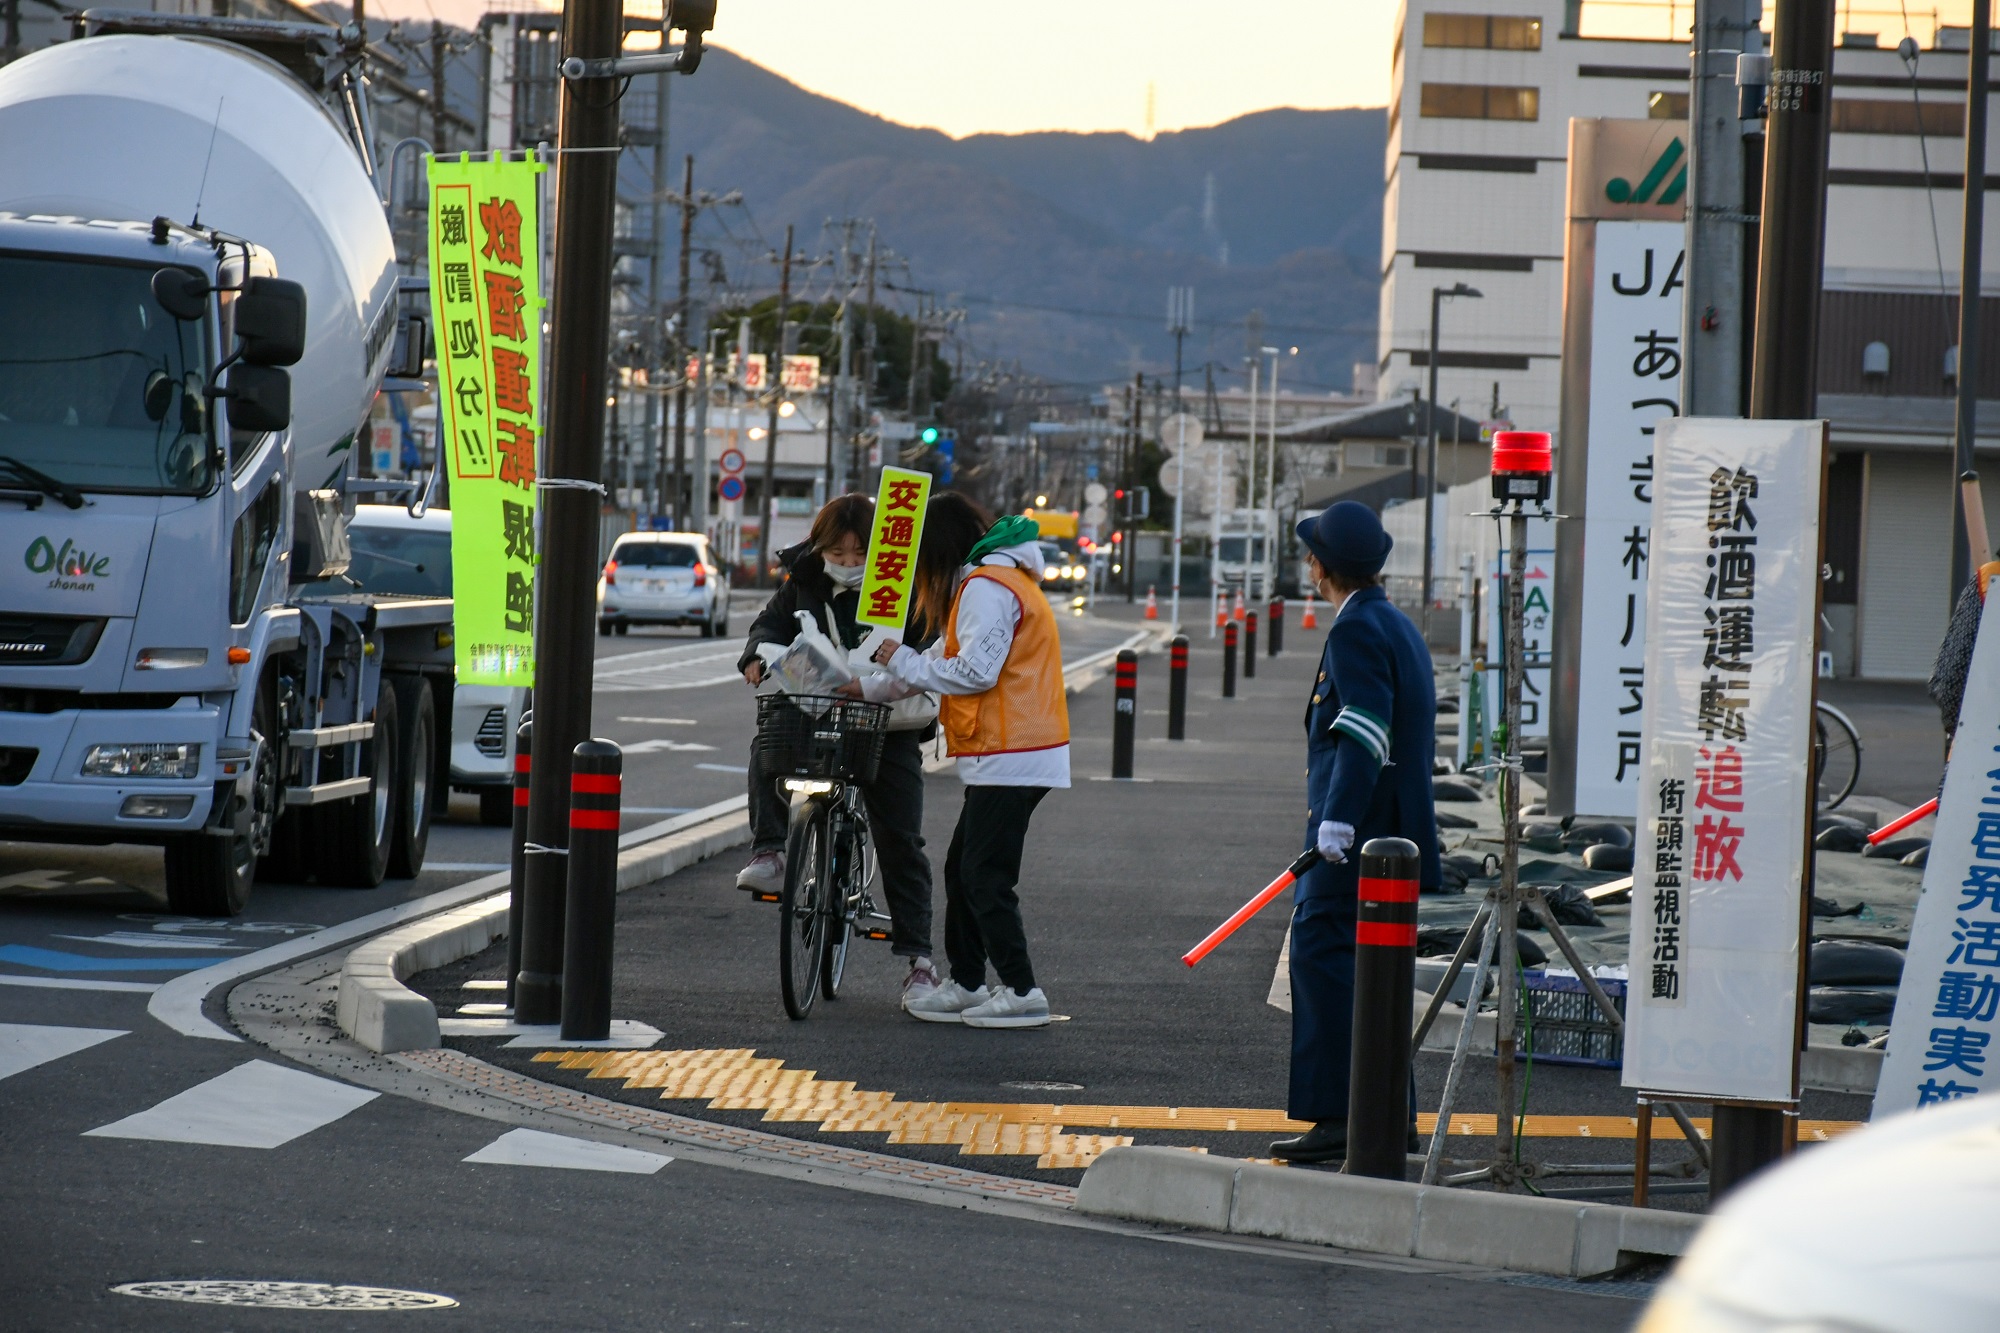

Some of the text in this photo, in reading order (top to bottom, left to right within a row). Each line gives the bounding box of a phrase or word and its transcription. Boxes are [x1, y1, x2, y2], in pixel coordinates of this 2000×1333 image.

[24, 535, 110, 577] Olive
[48, 578, 95, 592] shonan
[866, 479, 922, 618] 交通安全
[1692, 465, 1759, 883] 飲酒運転追放
[1651, 777, 1686, 1001] 街頭監視活動
